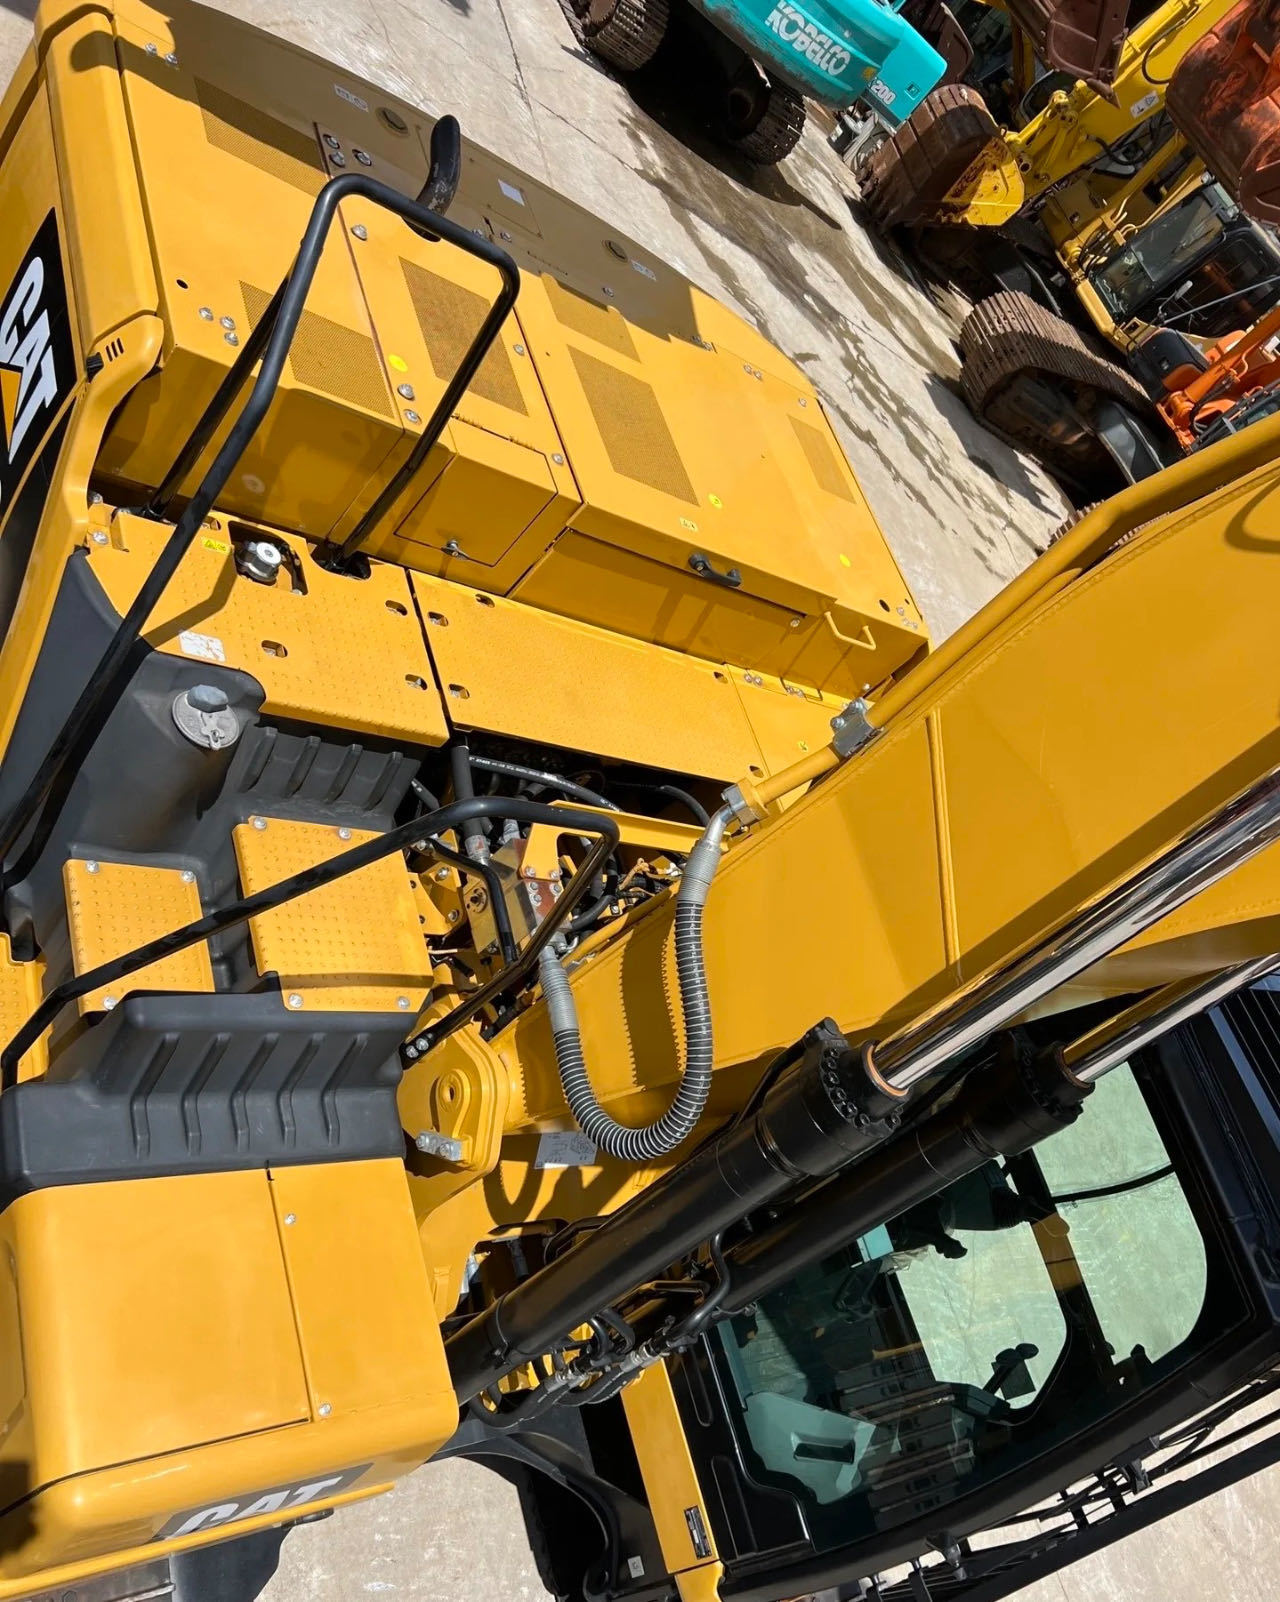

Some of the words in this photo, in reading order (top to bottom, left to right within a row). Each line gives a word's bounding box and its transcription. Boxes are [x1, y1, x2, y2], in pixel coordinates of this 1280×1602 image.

[765, 0, 850, 75] KOBELCO
[0, 256, 58, 465] CAT
[164, 1475, 344, 1541] CAT
